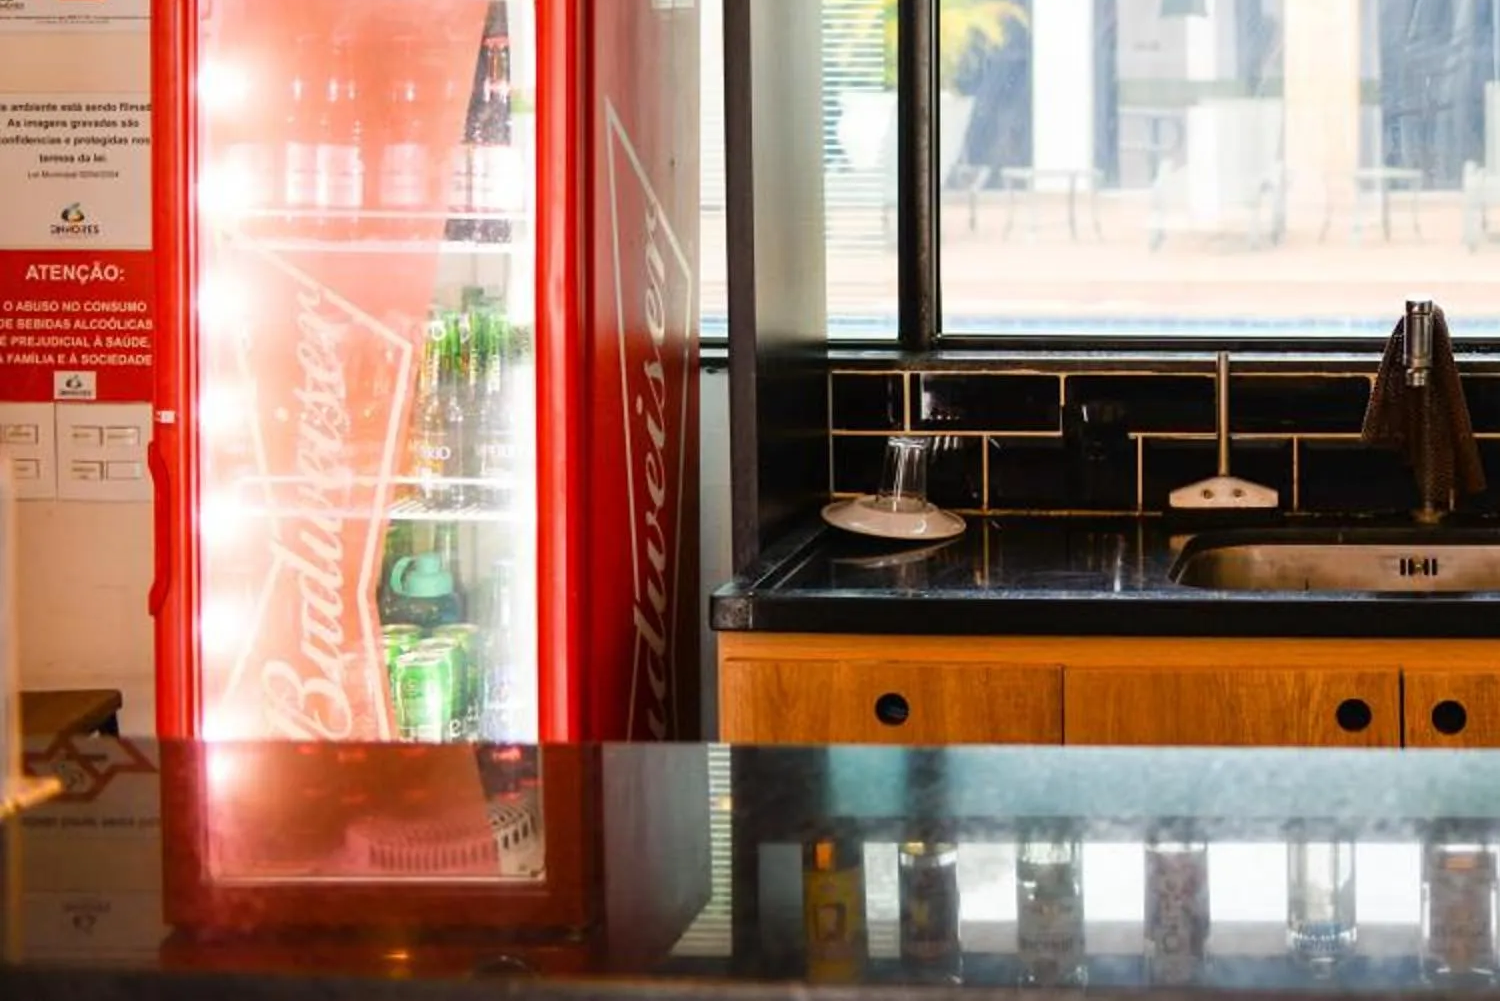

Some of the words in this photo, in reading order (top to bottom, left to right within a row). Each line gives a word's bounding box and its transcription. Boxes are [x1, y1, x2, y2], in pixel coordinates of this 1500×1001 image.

[86, 102, 117, 112] sendo
[7, 118, 21, 128] As
[24, 119, 68, 130] imagens
[73, 135, 129, 147] protegidas
[78, 153, 91, 163] da
[25, 261, 126, 286] ATENÇÃO:
[3, 301, 13, 312] O
[15, 300, 60, 312] ABUSO
[62, 300, 81, 312] NO
[83, 300, 147, 312] CONSUMO
[17, 318, 72, 330] BEBIDAS
[73, 316, 152, 330] ALCOÓLICAS
[11, 335, 91, 348] PREJUDICIAL
[7, 352, 56, 364] FAMÍLIA
[57, 353, 66, 364] E
